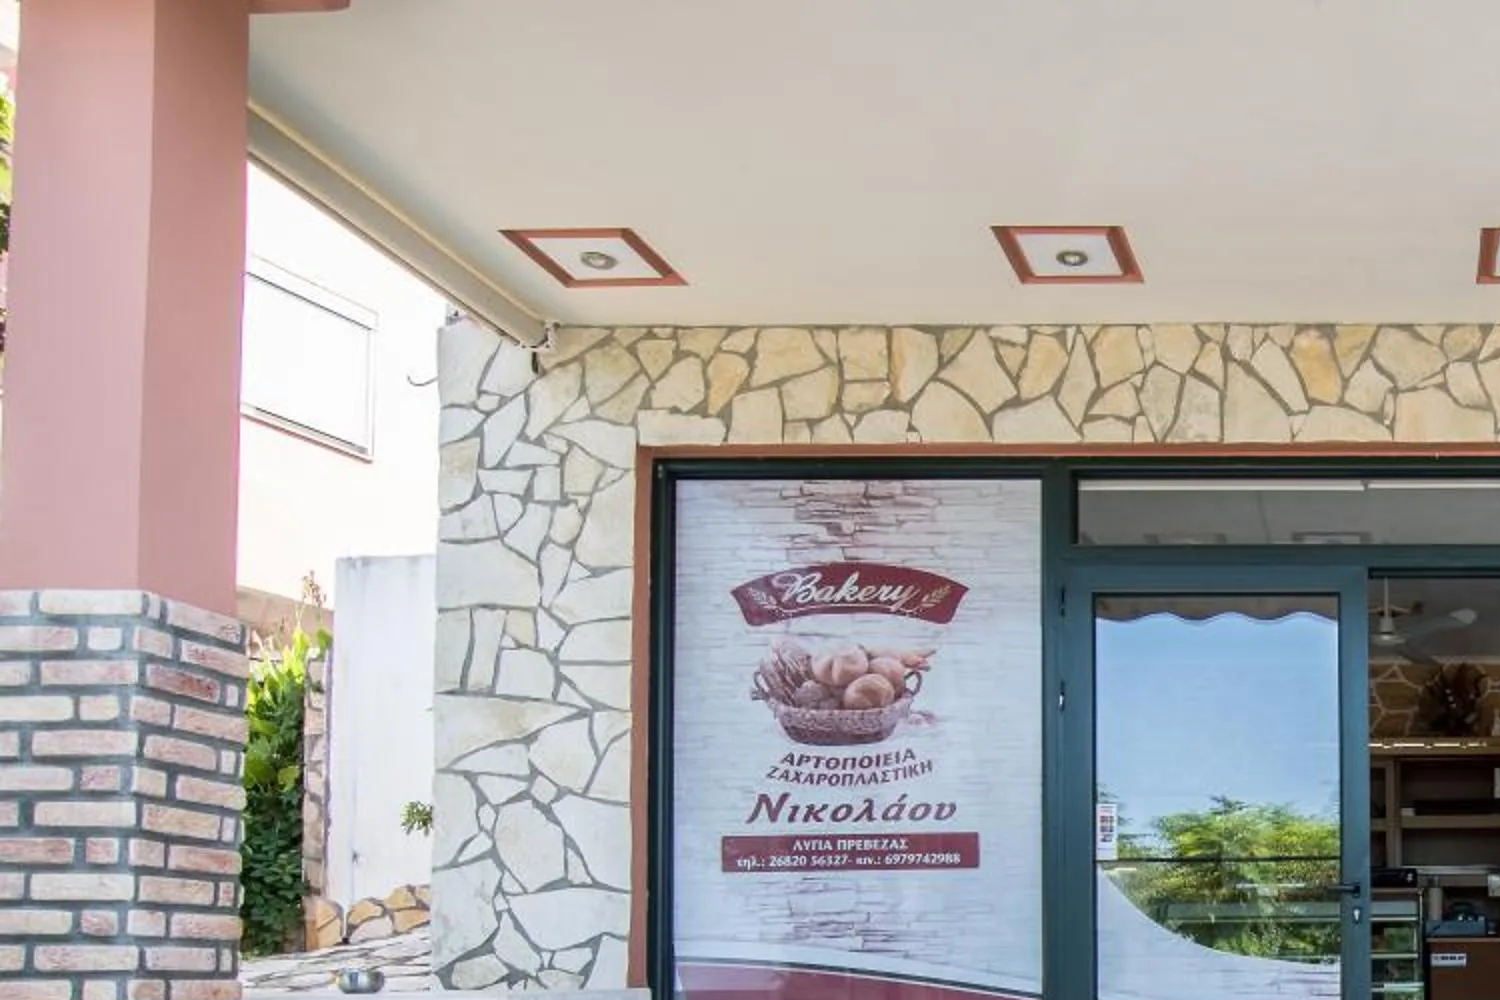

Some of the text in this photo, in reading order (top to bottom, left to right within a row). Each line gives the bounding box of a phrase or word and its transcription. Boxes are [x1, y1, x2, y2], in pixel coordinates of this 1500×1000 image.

[771, 571, 917, 611] Bakery
[780, 748, 916, 770] ΑΡΤΟΠΟΙΕΙΑ
[765, 759, 933, 787] ΖΑΧΑΡΟΠΛΑΣΤΙΚΗ
[745, 792, 957, 824] Νικολάου
[837, 838, 909, 850] ΠΡΕΒΕΖΑΣ
[769, 854, 807, 868] 26820
